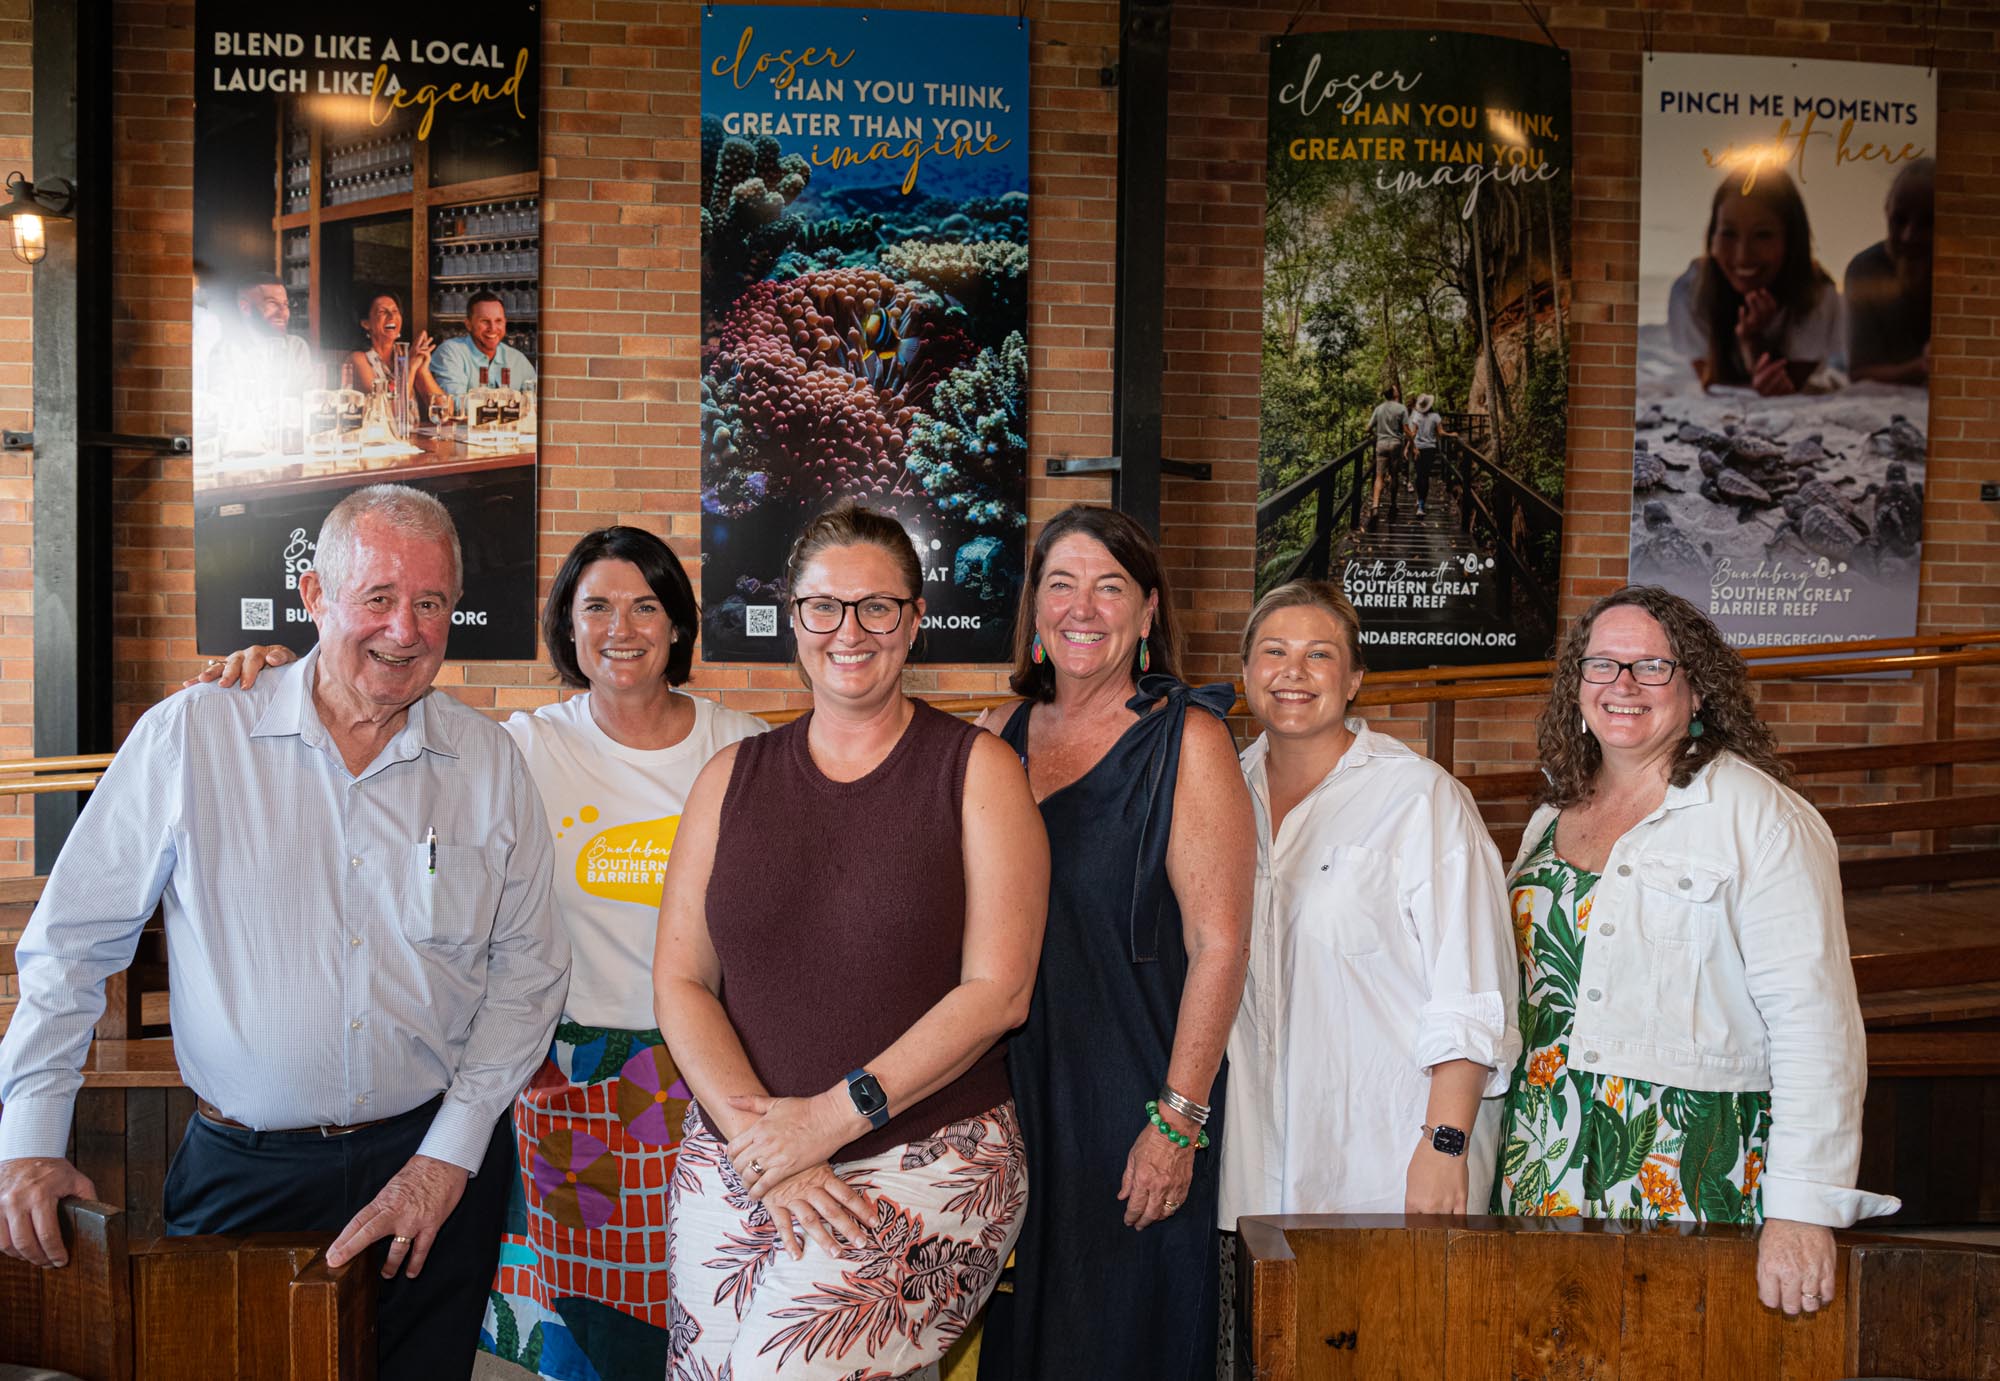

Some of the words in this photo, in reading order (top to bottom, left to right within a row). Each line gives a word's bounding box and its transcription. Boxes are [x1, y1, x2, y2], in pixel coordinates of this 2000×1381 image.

[214, 32, 304, 57] BLEND
[314, 34, 371, 60] LIKE
[381, 38, 400, 62] A
[411, 40, 504, 68] LOCAL
[711, 26, 855, 90] closer
[213, 67, 307, 93] LAUGH
[318, 70, 374, 95] LIKE
[384, 73, 401, 97] A
[369, 47, 529, 141] legend
[770, 77, 844, 102] THAN
[854, 80, 914, 104] YOU
[924, 83, 1011, 113] THINK,
[1279, 53, 1422, 116] closer
[1337, 103, 1411, 126] THAN
[1420, 104, 1477, 128] YOU
[1485, 107, 1559, 142] THINK,
[1660, 91, 1739, 115] PINCH
[1750, 95, 1784, 117] ME
[1793, 96, 1917, 125] MOMENTS
[722, 112, 840, 136] GREATER
[849, 114, 922, 139] THAN
[932, 117, 992, 143] YOU
[1836, 118, 1926, 166] here
[811, 133, 1011, 195] imagine
[1289, 138, 1405, 161] GREATER
[1415, 139, 1483, 164] THAN
[1493, 143, 1543, 170] YOU
[1376, 160, 1560, 220] imagine
[1343, 560, 1386, 582] North
[1390, 560, 1455, 586] Burnett
[1344, 580, 1427, 594] SOUTHERN
[1432, 582, 1479, 595] GREAT
[1711, 558, 1813, 591] Bundaberg
[1413, 595, 1447, 608] REEF
[1710, 601, 1777, 615] BARRIER
[1783, 602, 1818, 616] REEF
[1711, 586, 1797, 600] SOUTHERN
[1803, 588, 1852, 602] GREAT
[1358, 631, 1516, 646] NDABERGREGION.ORG
[587, 836, 671, 860] Bundaber
[587, 871, 650, 884] BARRIER
[588, 859, 668, 871] SOUTHERN
